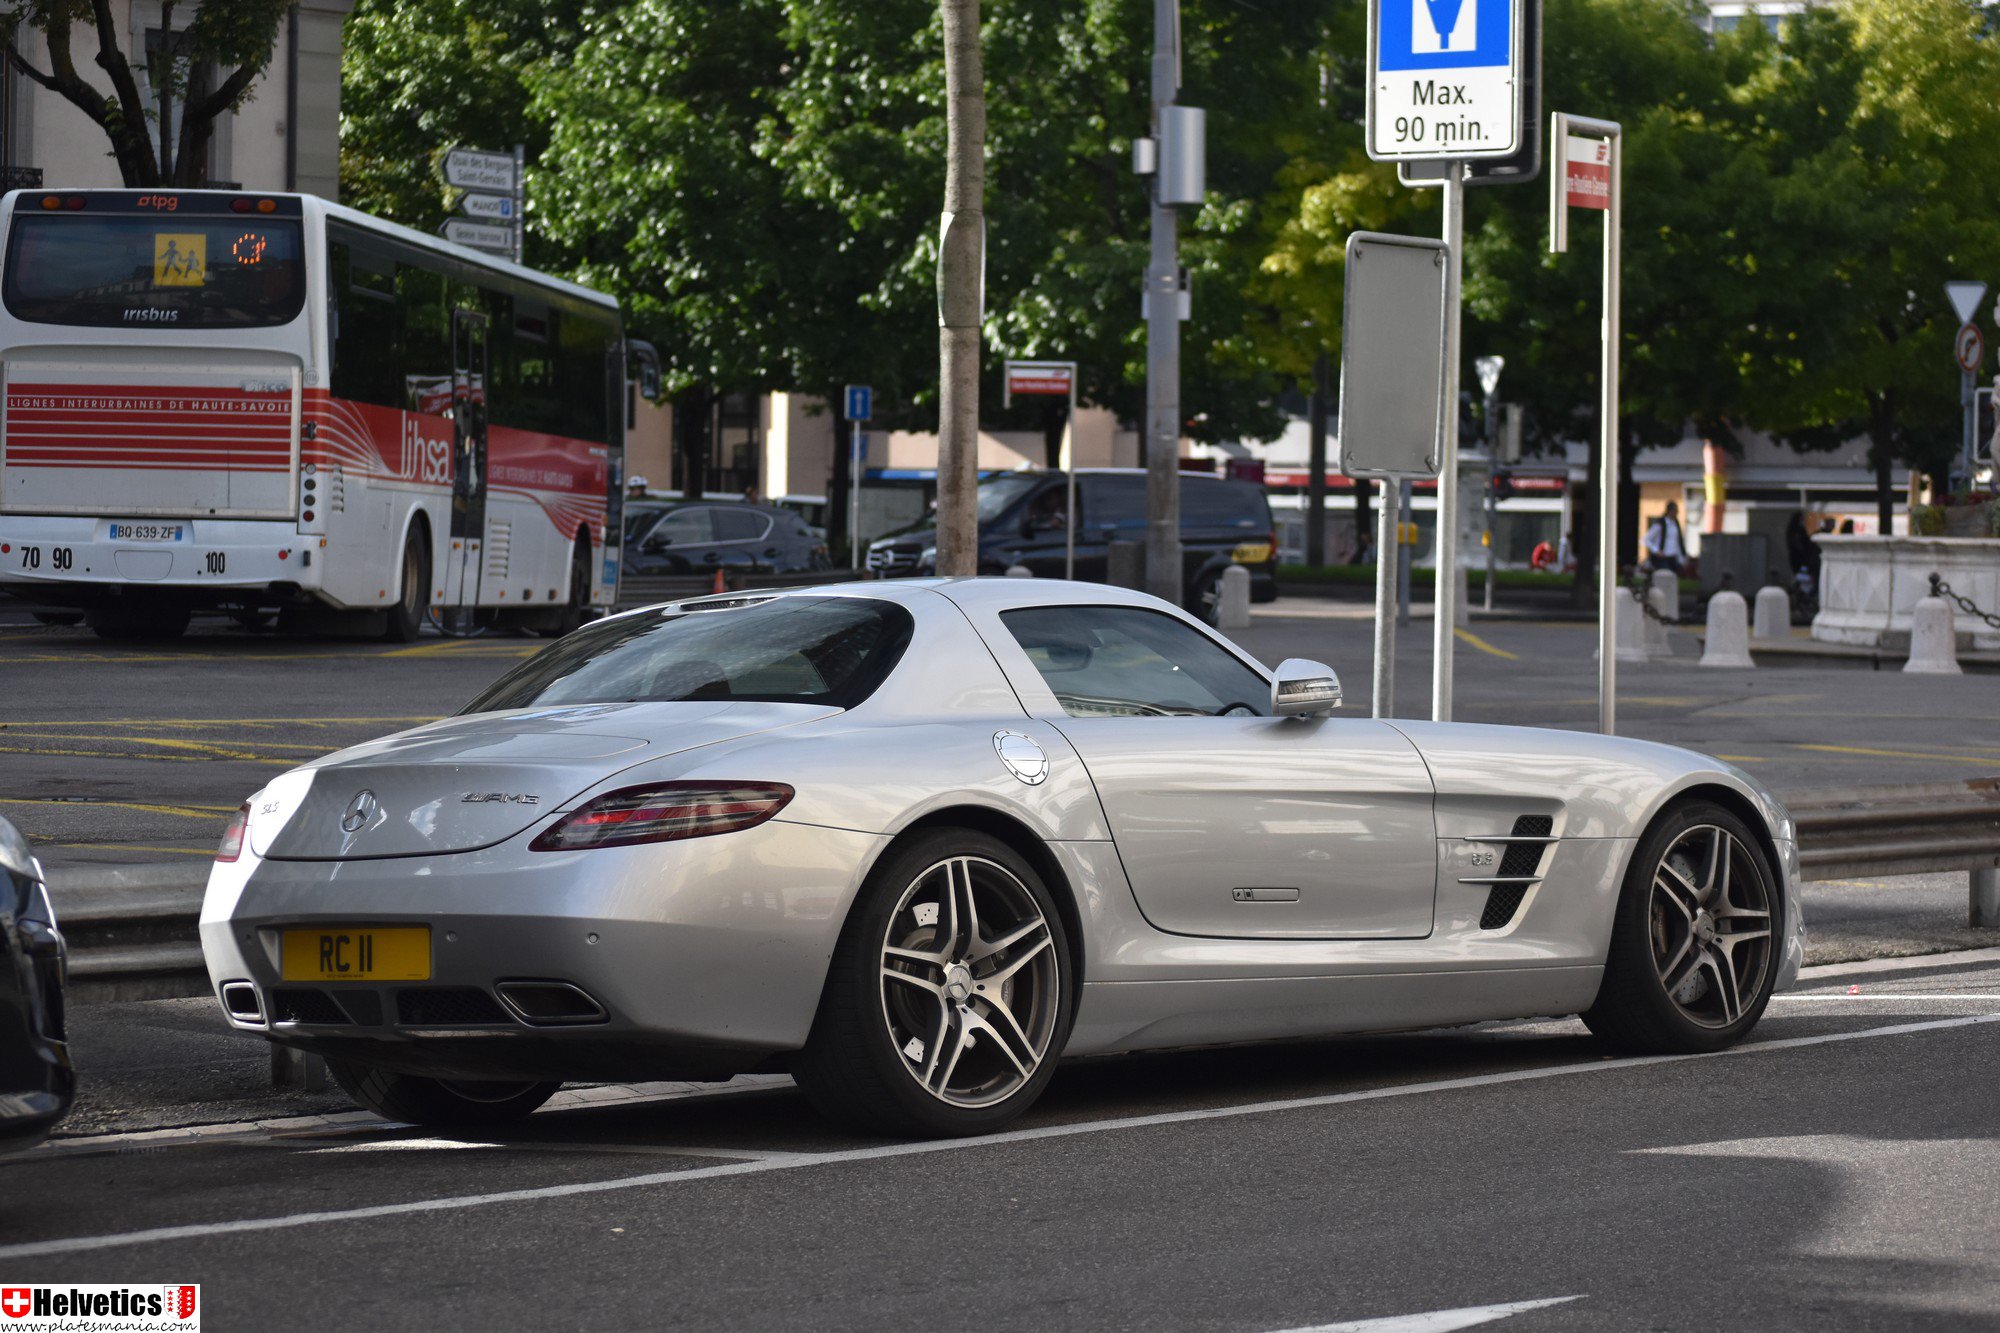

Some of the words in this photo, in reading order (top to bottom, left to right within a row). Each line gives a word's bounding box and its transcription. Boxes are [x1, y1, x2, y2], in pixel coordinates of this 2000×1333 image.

[1412, 80, 1473, 105] Max.
[1395, 116, 1424, 142] 90
[1436, 114, 1489, 142] min.
[152, 195, 178, 211] tpg
[123, 307, 178, 322] irisbus
[10, 398, 55, 408] LIGNES
[62, 398, 162, 410] INTERURBAINES
[169, 400, 184, 410] DE
[192, 401, 290, 412] HAUTE-SAVOIE
[401, 409, 454, 484] lihsa
[21, 546, 40, 568] 70
[53, 547, 72, 570] 90
[206, 551, 225, 573] 100
[261, 801, 280, 815] SLS
[320, 935, 350, 972] RC
